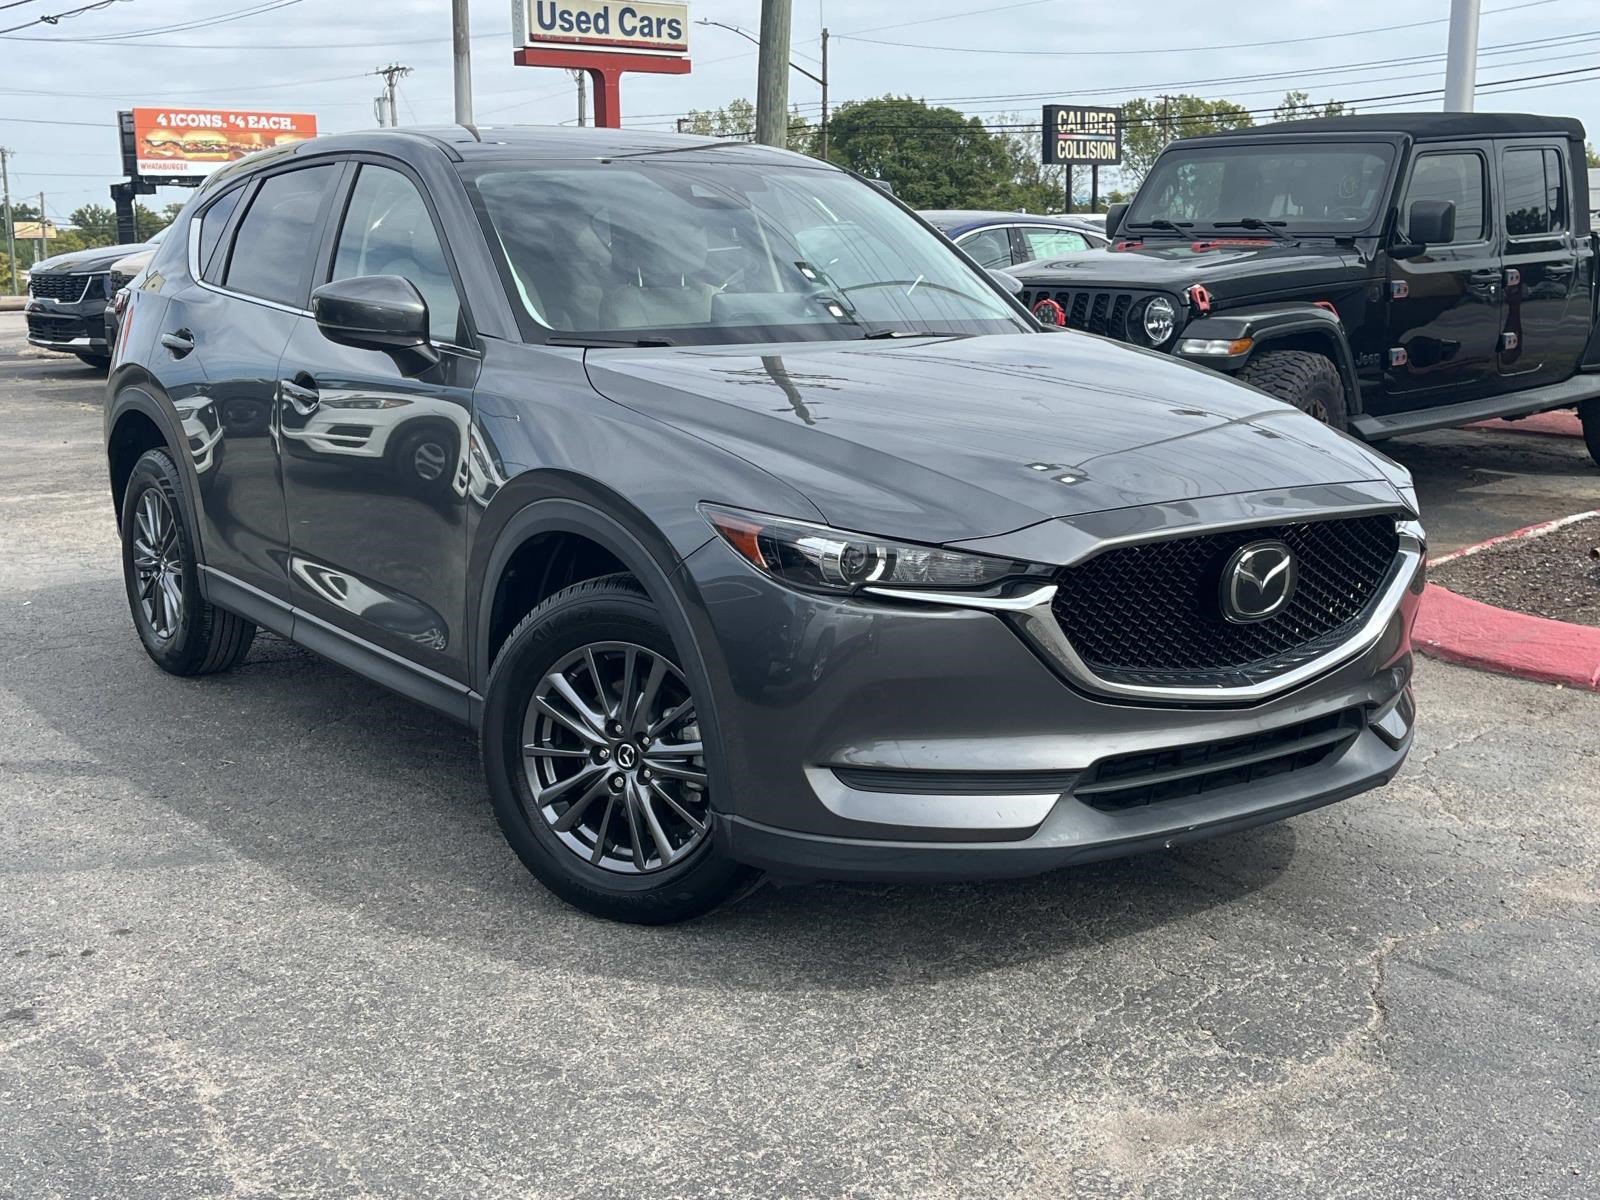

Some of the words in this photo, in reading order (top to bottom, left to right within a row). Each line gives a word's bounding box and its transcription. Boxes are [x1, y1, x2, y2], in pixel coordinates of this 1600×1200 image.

[537, 1, 610, 35] Used
[618, 7, 682, 40] Cars
[156, 113, 168, 127] 4
[169, 113, 227, 129] ICONS.
[247, 116, 297, 131] EACH.
[1057, 110, 1116, 135] CALIBER
[1057, 140, 1116, 160] COLLISION
